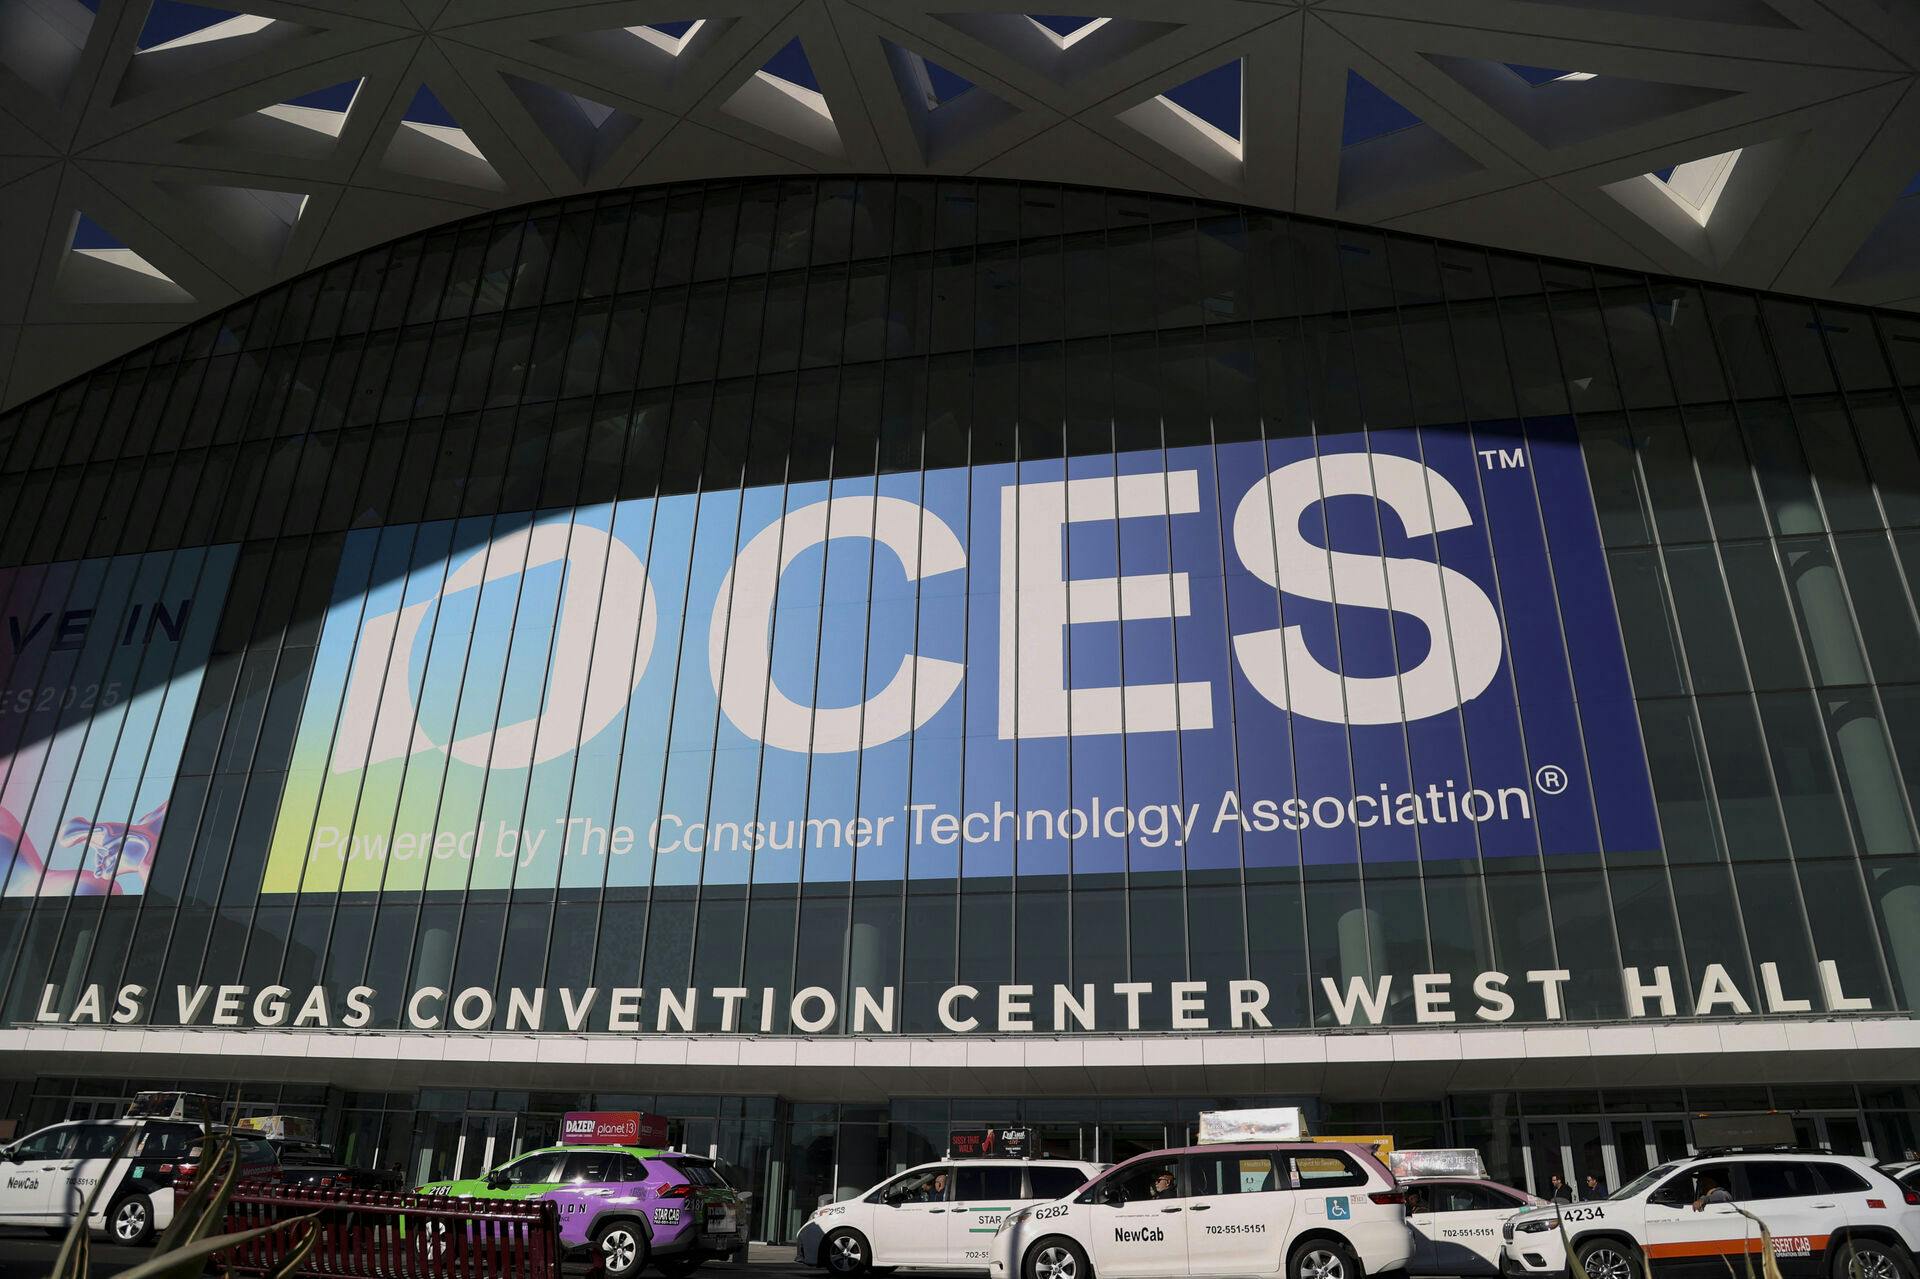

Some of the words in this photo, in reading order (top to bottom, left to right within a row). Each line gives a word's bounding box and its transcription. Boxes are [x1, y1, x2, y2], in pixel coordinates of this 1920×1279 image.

[1478, 447, 1525, 470] TM
[708, 452, 1503, 755] CES
[122, 599, 192, 646] IN
[312, 821, 486, 862] Powered
[494, 820, 547, 868] by
[555, 817, 636, 856] The
[648, 814, 894, 854] Consumer
[903, 796, 1200, 848] Technology
[36, 983, 147, 1023] LAS
[176, 984, 377, 1028] VEGAS
[408, 985, 895, 1032] CONVENTION
[937, 979, 1273, 1033] CENTER
[1320, 968, 1571, 1025] WEST
[1623, 960, 1873, 1018] HALL
[597, 1123, 625, 1136] planet
[7, 1177, 39, 1189] NewCab
[428, 1185, 452, 1196] 2181
[654, 1208, 668, 1220] STAR
[668, 1208, 680, 1221] CAB
[1035, 1204, 1069, 1220] 6282
[1563, 1207, 1605, 1223] 4234
[978, 1215, 1001, 1225] STAR
[1114, 1227, 1164, 1242] NewCab
[1205, 1224, 1265, 1234] 702-551-5151
[1442, 1228, 1495, 1238] 702-551-5151
[1794, 1237, 1811, 1251] CAB
